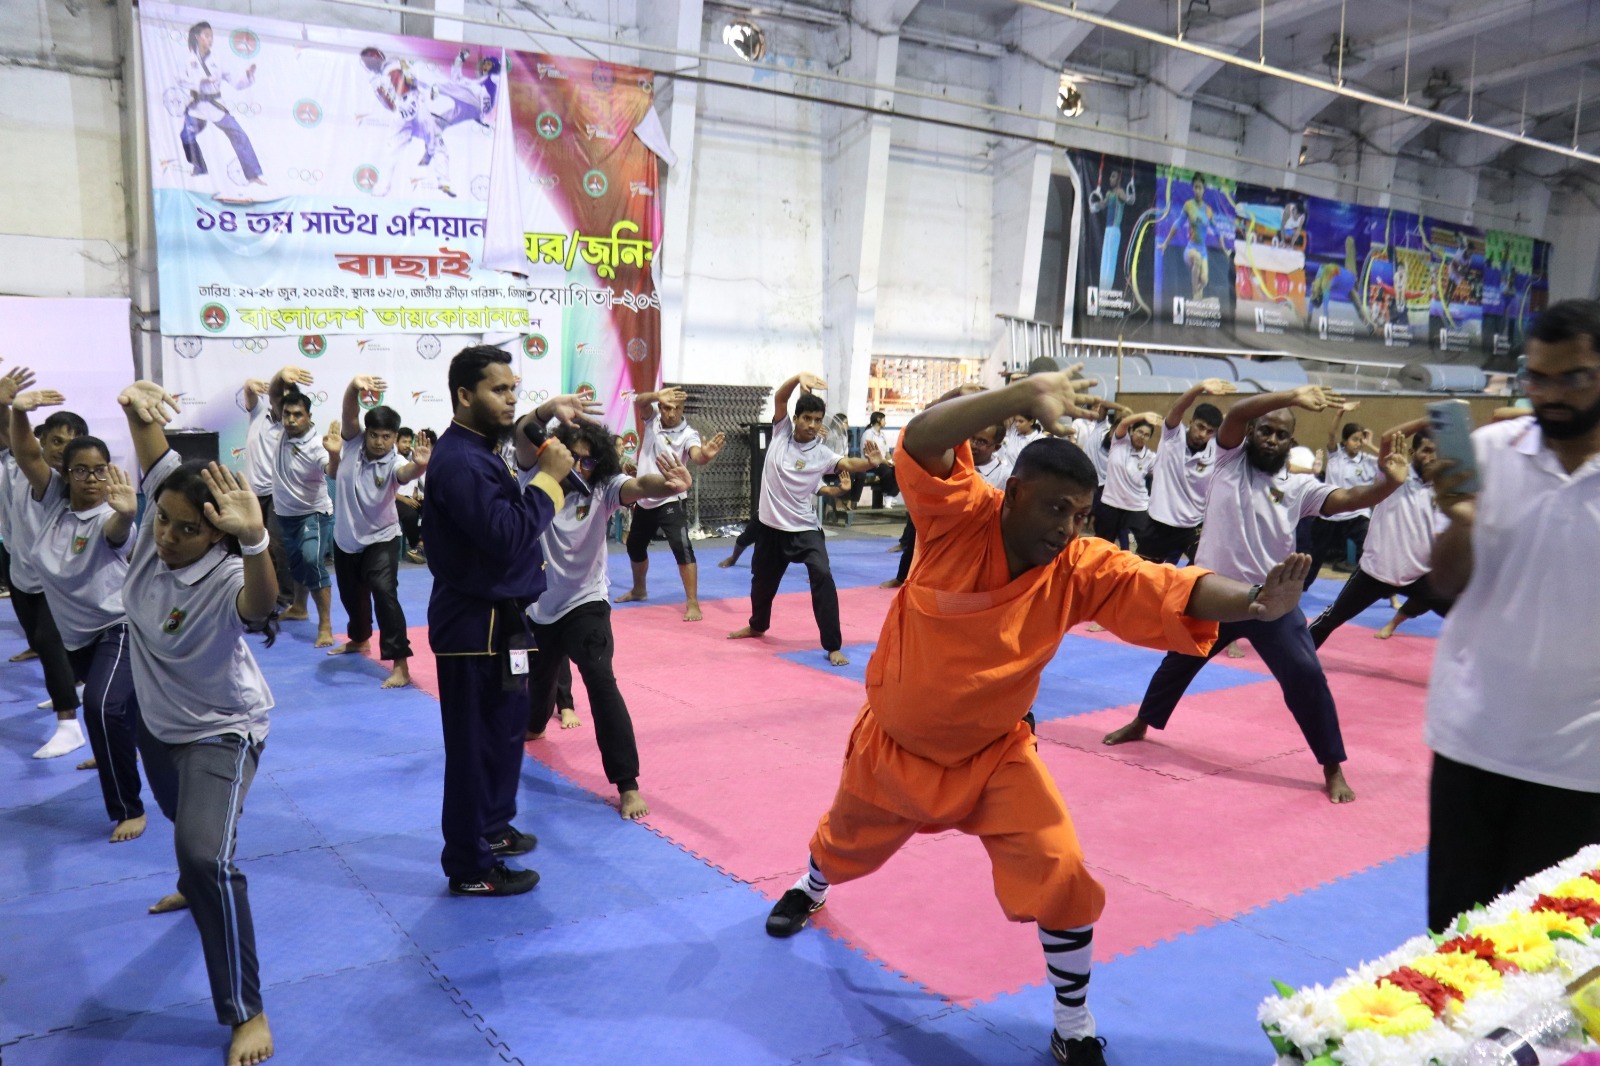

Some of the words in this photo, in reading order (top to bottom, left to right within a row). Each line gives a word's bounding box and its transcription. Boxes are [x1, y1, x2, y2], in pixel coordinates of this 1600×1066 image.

[196, 206, 238, 233] ১৪
[245, 211, 294, 234] তম
[300, 206, 378, 236] সাউথ
[334, 246, 474, 281] বাছাই
[198, 283, 231, 298] তারিখ
[277, 287, 300, 302] জুন,
[410, 285, 442, 300] জাতীয়
[444, 285, 468, 301] ক্রীড়া
[236, 305, 369, 332] বাংলাদেশ
